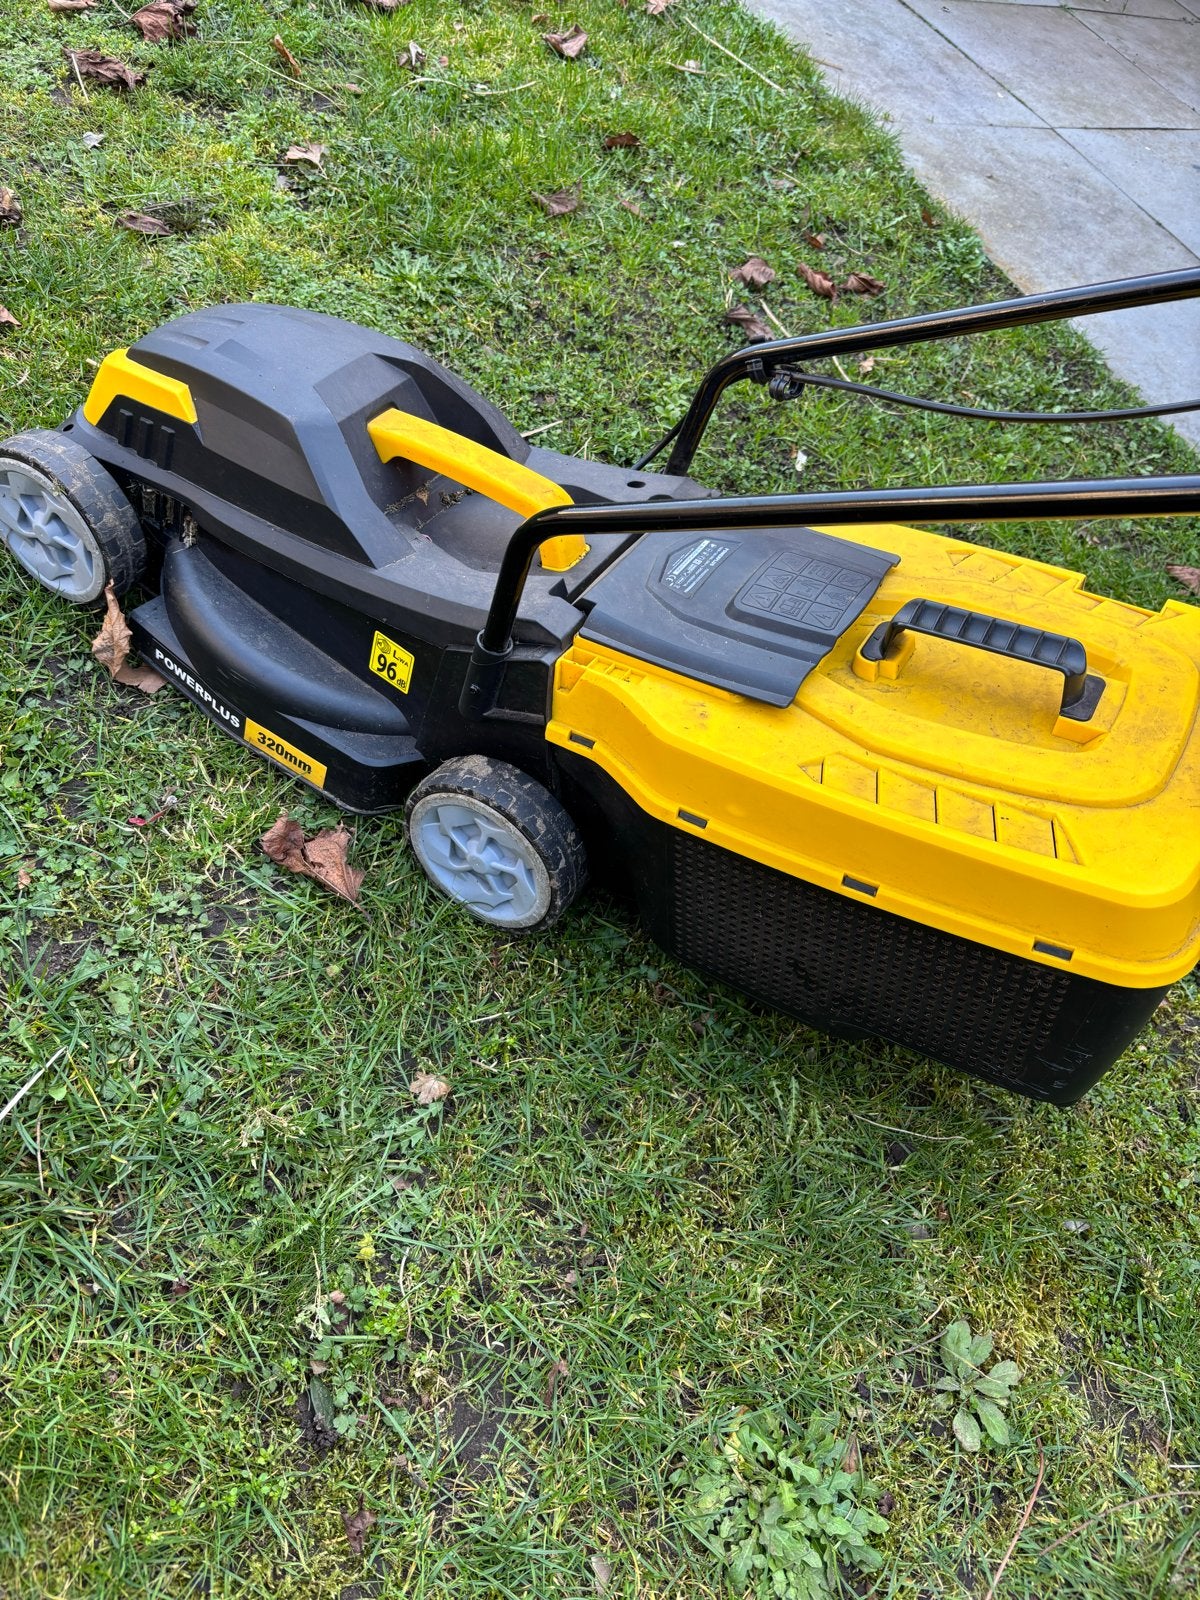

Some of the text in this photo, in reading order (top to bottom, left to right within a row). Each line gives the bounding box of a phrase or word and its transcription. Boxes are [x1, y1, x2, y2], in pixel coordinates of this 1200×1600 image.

[376, 653, 397, 681] 96
[396, 678, 406, 689] dB
[154, 648, 241, 728] POWERPLUS
[256, 731, 312, 775] 320mm
